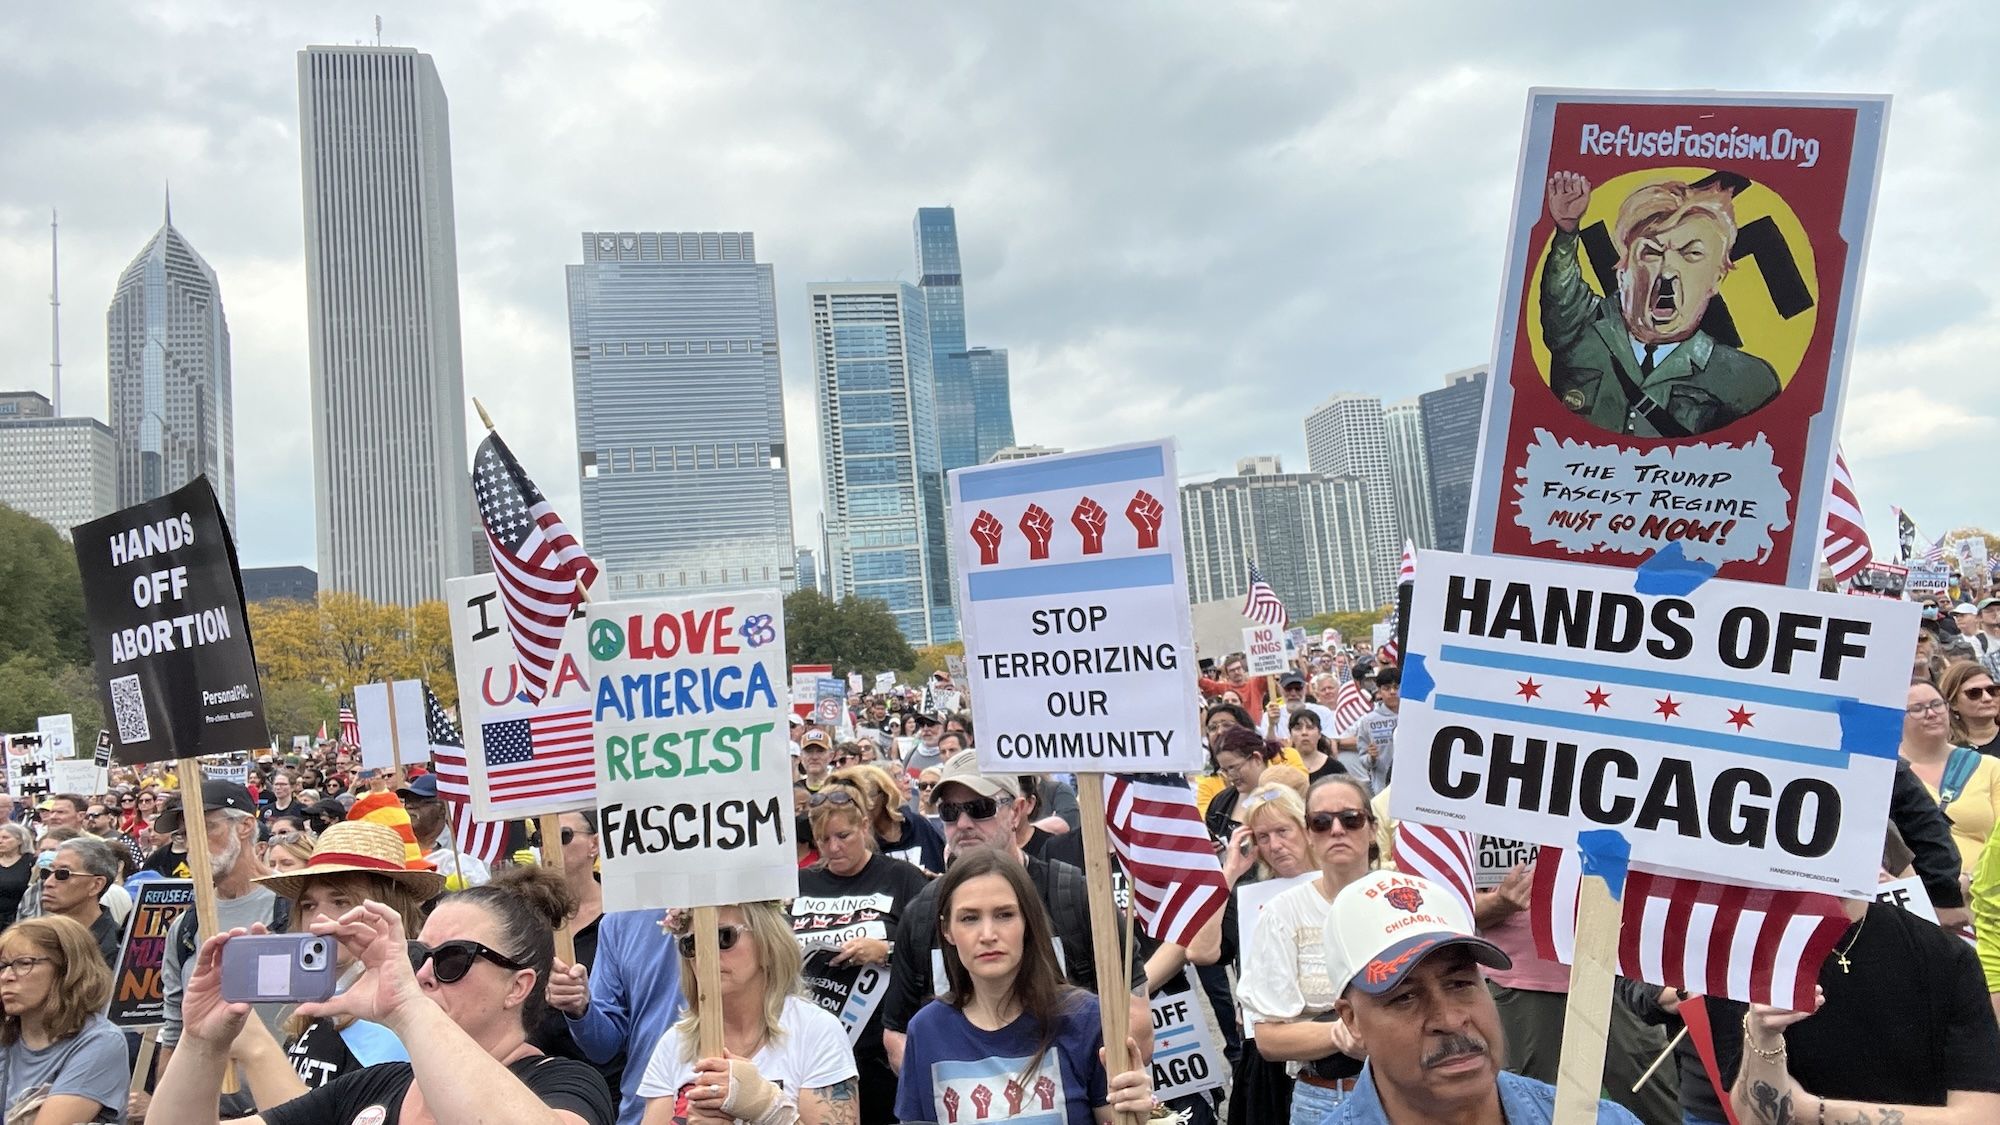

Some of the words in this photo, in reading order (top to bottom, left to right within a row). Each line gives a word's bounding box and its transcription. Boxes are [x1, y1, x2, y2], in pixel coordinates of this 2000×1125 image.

[1580, 123, 1820, 168] RefuseFascism.Org
[1565, 462, 1616, 480] THE
[1634, 464, 1732, 488] TRUMP
[1542, 481, 1642, 506] FASCIST
[1649, 490, 1758, 519] REGIME
[109, 511, 195, 567] HANDS
[1547, 509, 1602, 533] MUST
[1608, 513, 1635, 534] GO
[1639, 514, 1737, 545] NOW!
[133, 565, 189, 609] OFF
[1907, 580, 1947, 588] CHICAGO
[111, 605, 231, 665] ABORTION
[467, 591, 500, 642] I
[628, 607, 741, 660] LOVE
[1032, 605, 1108, 636] STOP
[1443, 575, 1696, 660] HANDS
[1718, 606, 1872, 681] OFF
[1250, 641, 1282, 656] KINGS
[1254, 629, 1273, 643] NO
[482, 653, 591, 706] UA
[978, 643, 1178, 680] TERRORIZING
[595, 661, 778, 722] AMERICA
[1047, 689, 1109, 718] OUR
[606, 722, 775, 782] RESIST
[996, 729, 1175, 759] COMMUNITY
[204, 766, 229, 776] HANDS
[230, 767, 245, 775] OFF
[1428, 725, 1842, 858] CHICAGO
[600, 796, 787, 860] FASCISM
[1480, 846, 1539, 868] OLIGA
[804, 899, 826, 912] NO
[831, 895, 877, 911] KINGS
[1365, 877, 1428, 899] BEARS
